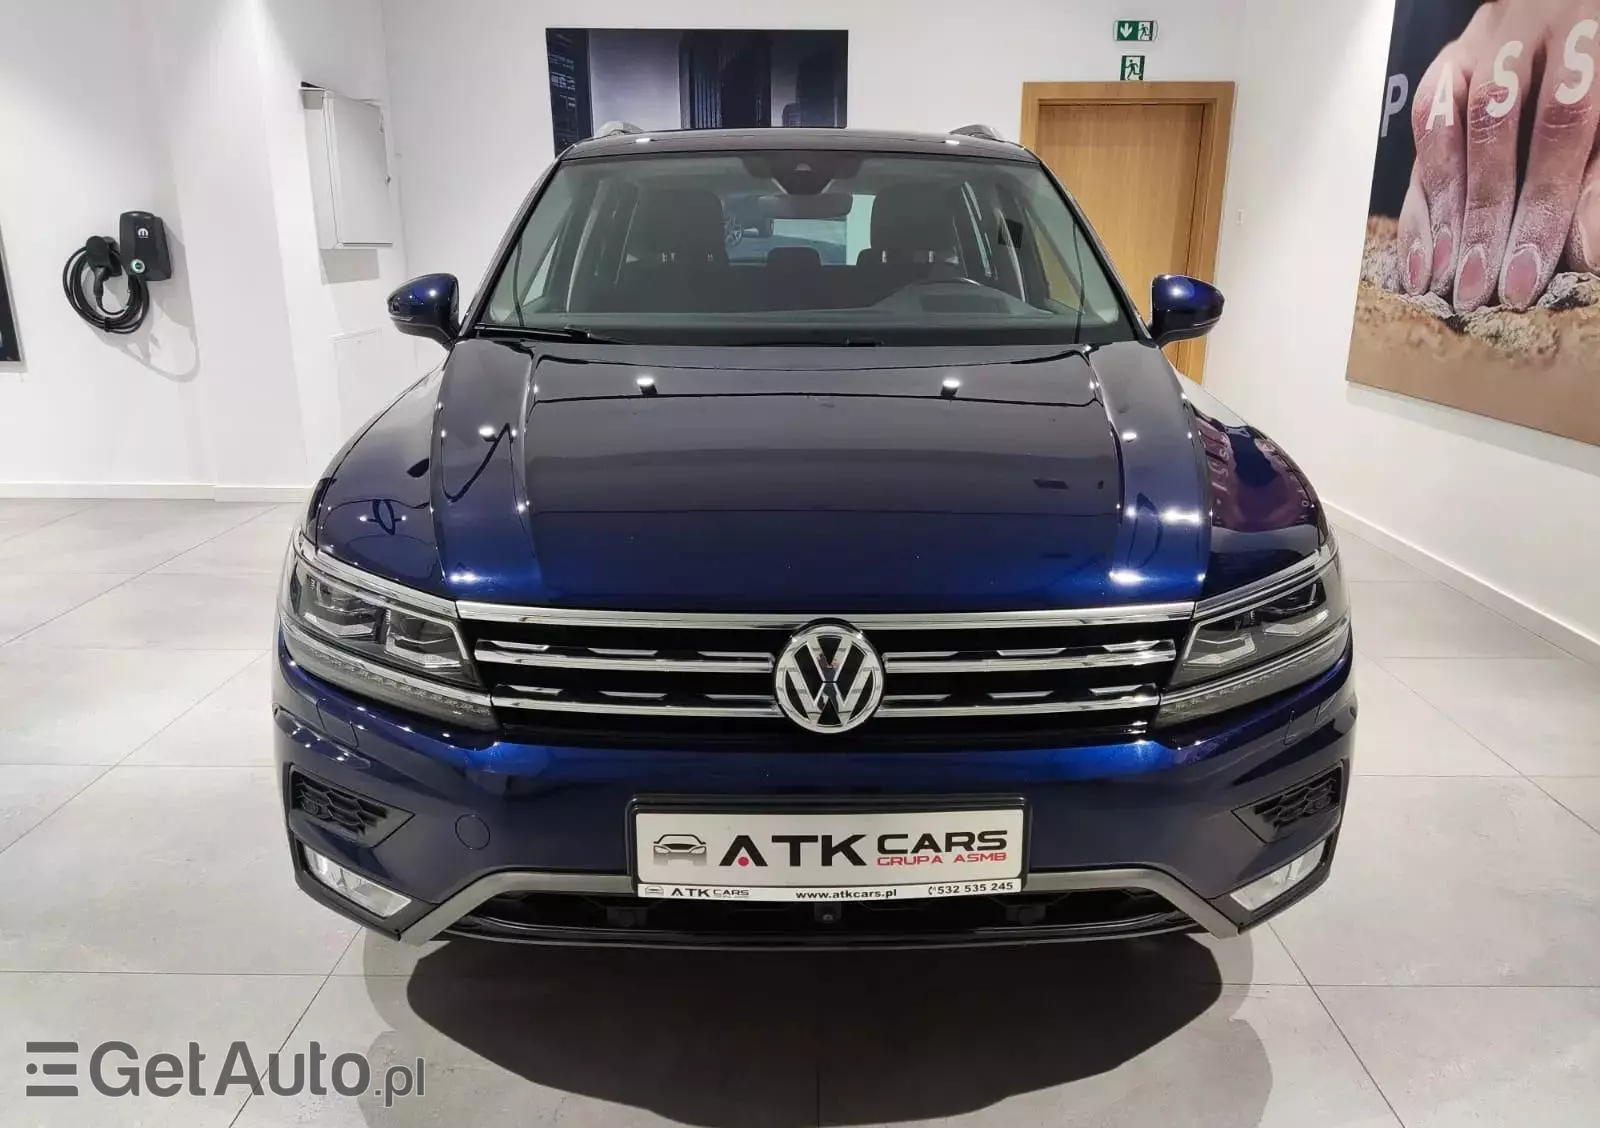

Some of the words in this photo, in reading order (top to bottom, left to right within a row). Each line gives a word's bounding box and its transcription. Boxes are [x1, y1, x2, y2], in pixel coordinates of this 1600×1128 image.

[718, 833, 868, 868] ATK
[877, 829, 1008, 855] CARS
[877, 855, 943, 866] GRUPA
[953, 852, 1007, 863] ASMB
[671, 887, 710, 898] ATK
[795, 889, 897, 899] www.atkcars.pl
[937, 885, 960, 895] 532
[964, 884, 987, 893] 535
[991, 882, 1013, 891] 245
